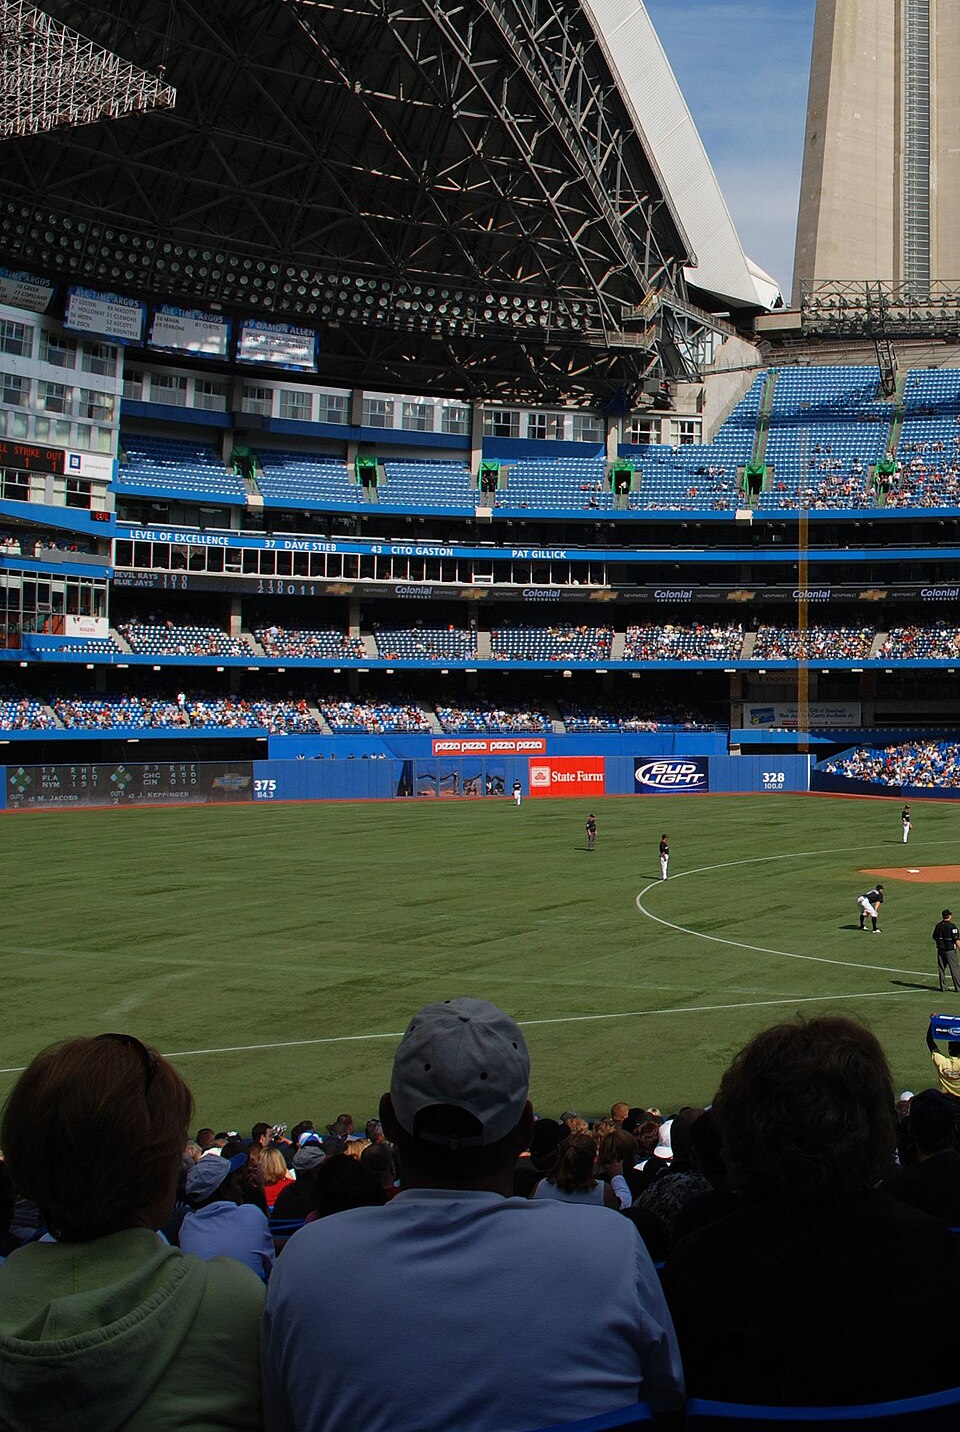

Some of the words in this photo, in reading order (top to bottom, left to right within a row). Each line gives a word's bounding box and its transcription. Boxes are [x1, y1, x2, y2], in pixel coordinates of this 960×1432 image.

[78, 300, 96, 308] LUSTER
[113, 295, 139, 308] ARGOS
[78, 307, 105, 316] HOLLOWAY
[113, 315, 137, 323] CLEMONS
[200, 312, 224, 323] ARGOS
[256, 322, 288, 333] DAMON
[290, 327, 315, 336] ALLEN
[14, 446, 40, 458] STRIKE
[46, 451, 62, 460] OUT
[25, 458, 30, 468] 1
[52, 461, 56, 472] 1
[130, 530, 156, 540] LEVEL
[160, 532, 171, 541] OF
[174, 533, 230, 545] EXCELLENCE
[265, 540, 276, 548] 37
[284, 541, 309, 550] DAVE
[312, 542, 337, 552] STIEB
[371, 545, 382, 553] 43
[391, 546, 413, 555] CITO
[416, 547, 453, 556] GASTON
[512, 550, 529, 558] PAT
[532, 550, 567, 559] GILLICK
[114, 571, 136, 579] DEVIL
[137, 572, 158, 580] RAYS
[288, 585, 294, 594] 0
[395, 585, 433, 595] Colonial
[522, 588, 561, 598] Colonial
[654, 590, 693, 598] Colonial
[792, 590, 831, 598] Colonial
[921, 588, 960, 598] Colonial
[435, 742, 460, 753] pizza
[462, 741, 487, 752] pizza
[490, 741, 516, 752] pizza
[516, 741, 543, 752] pizza
[650, 764, 697, 774] BUD
[551, 772, 576, 782] State
[577, 770, 604, 782] Farm
[644, 773, 704, 784] LIGHT
[763, 773, 785, 782] 328
[254, 780, 277, 791] 375
[147, 791, 189, 799] KEPPINGER
